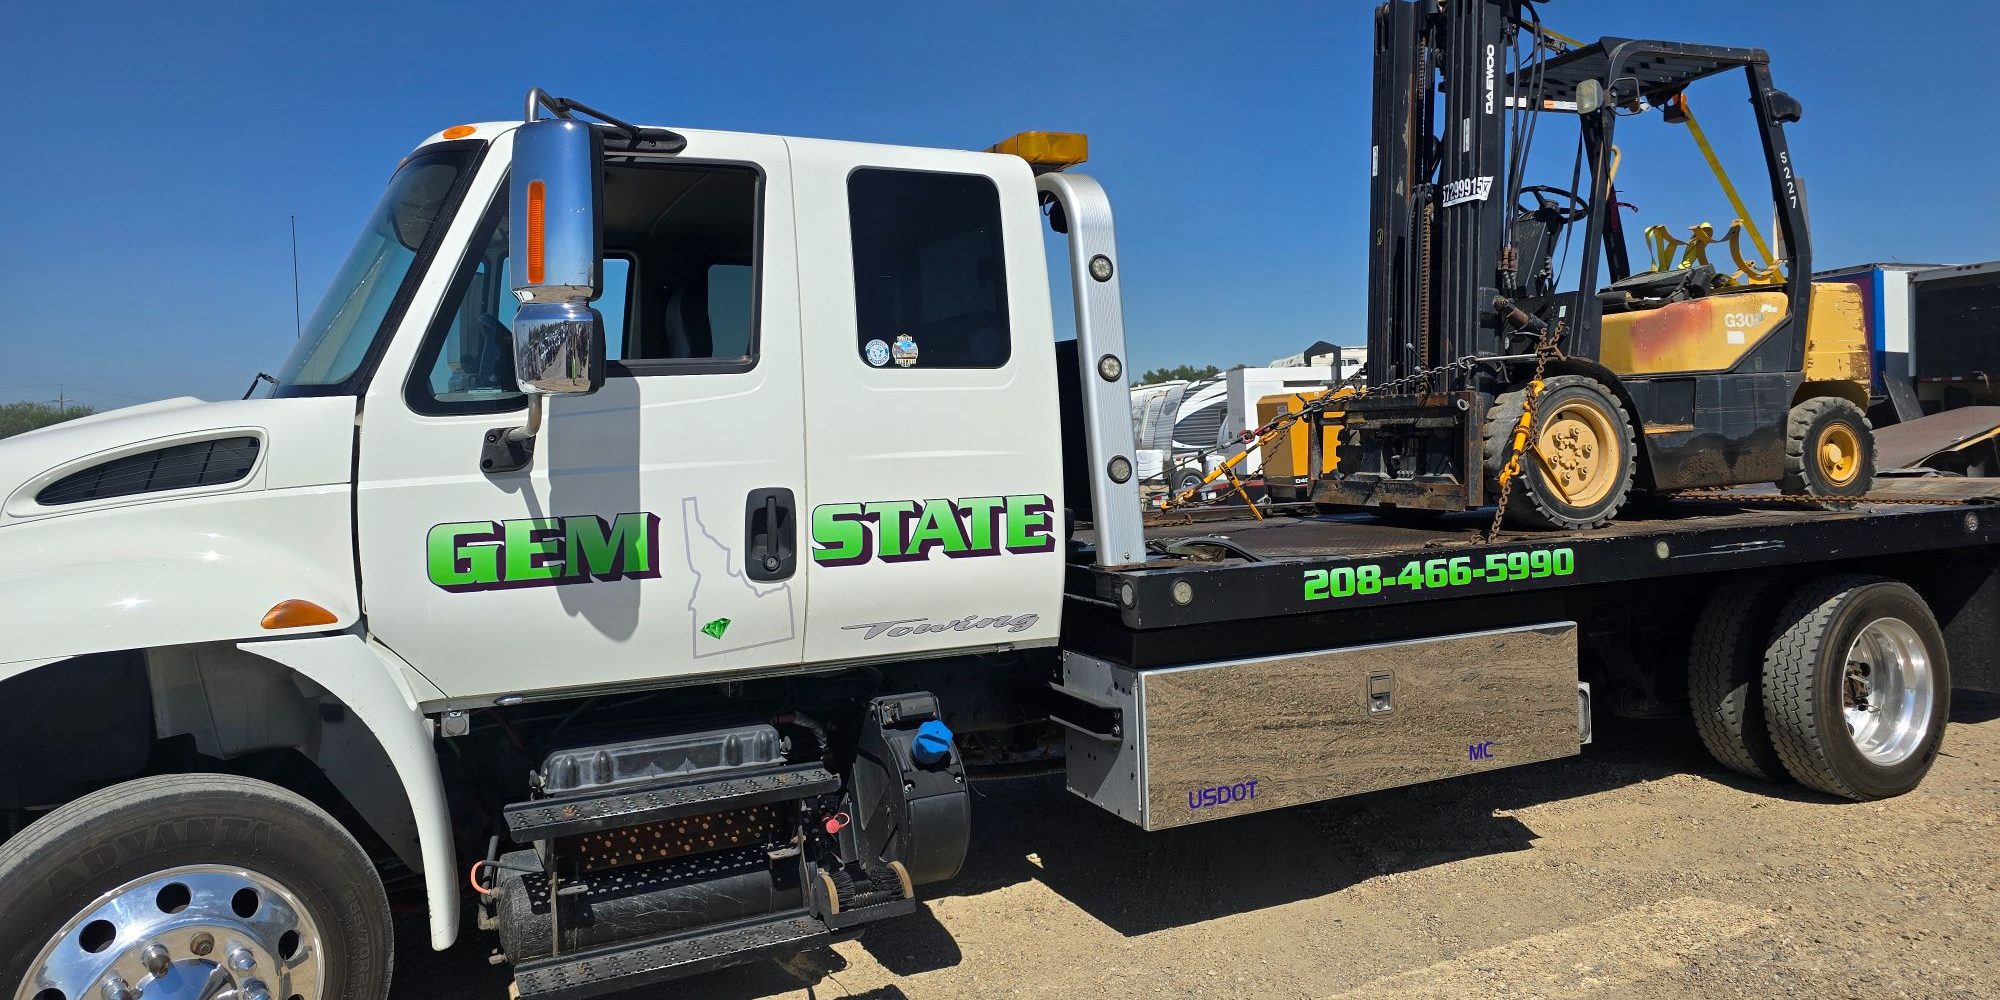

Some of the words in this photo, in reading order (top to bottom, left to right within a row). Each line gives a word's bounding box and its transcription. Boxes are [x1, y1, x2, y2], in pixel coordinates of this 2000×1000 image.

[1485, 44, 1495, 115] DAEWOO
[1780, 151, 1797, 209] 5227
[426, 511, 662, 594] GEM
[811, 493, 1056, 568] STATE
[1303, 547, 1575, 601] 208-466-5990
[840, 613, 1040, 641] Towing
[1468, 741, 1495, 761] MC
[1188, 779, 1259, 810] USDOT
[46, 817, 273, 894] ADVANTA
